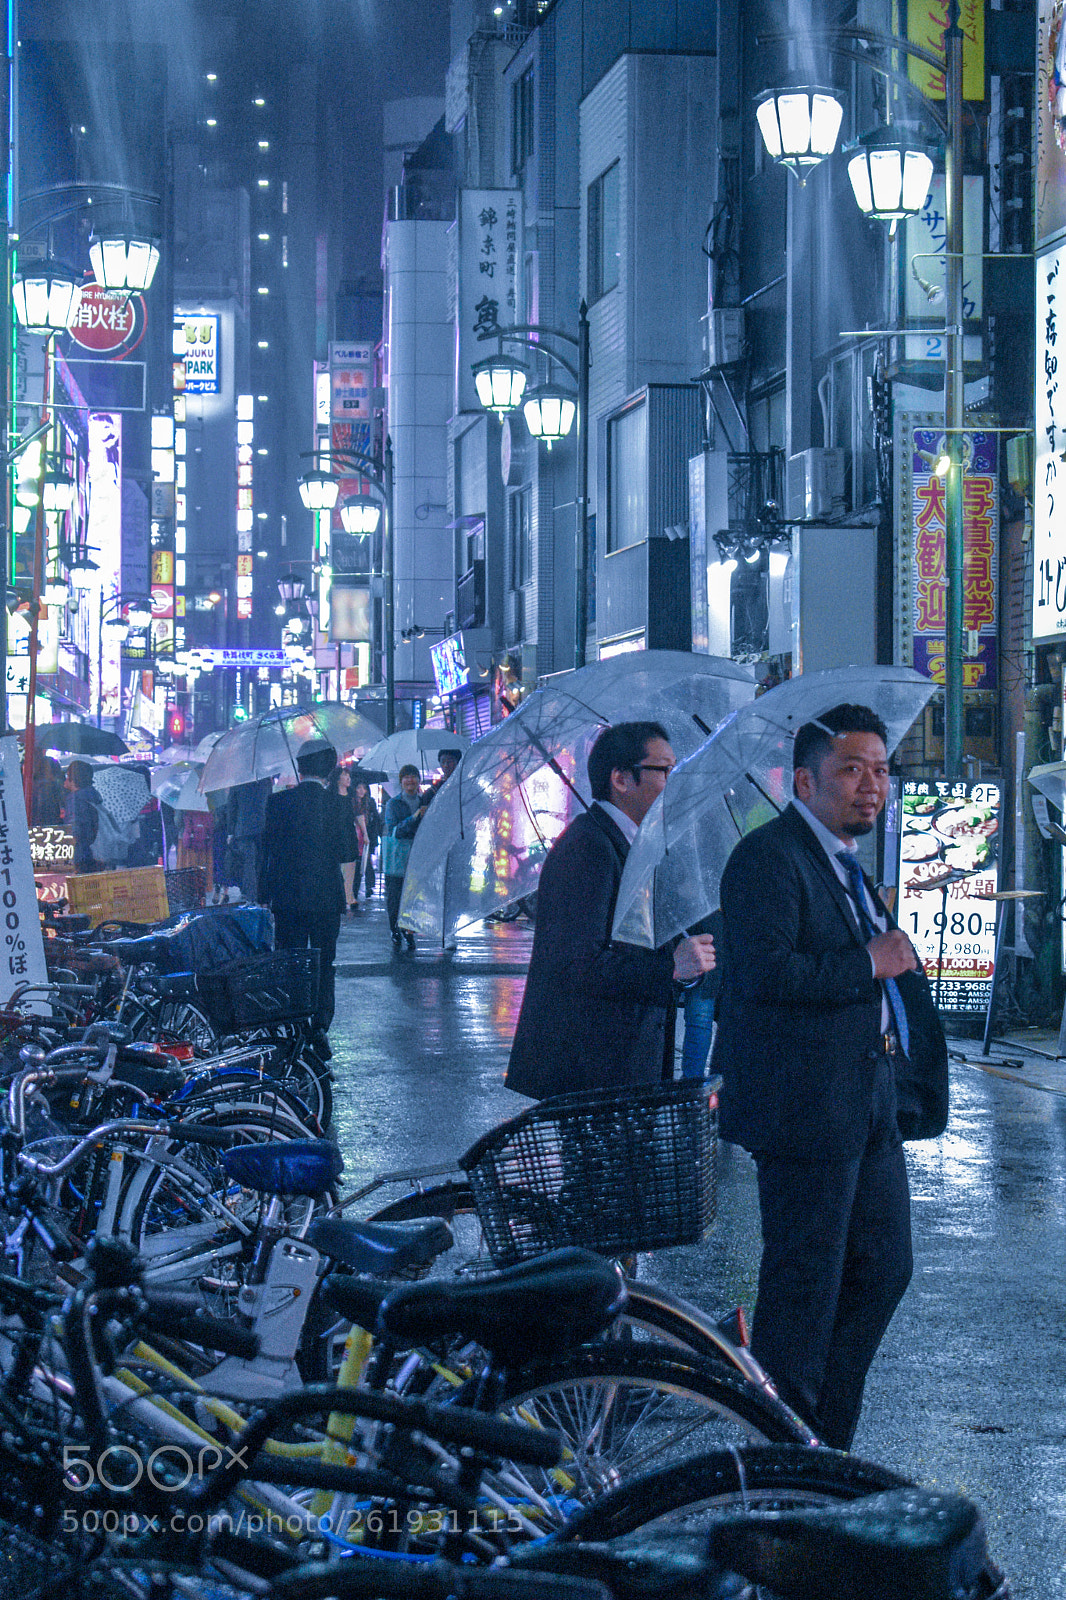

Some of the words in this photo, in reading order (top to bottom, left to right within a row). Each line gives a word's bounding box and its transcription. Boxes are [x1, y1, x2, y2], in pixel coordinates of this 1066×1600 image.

[75, 302, 129, 331] 消火栓
[926, 337, 942, 357] 2
[915, 475, 947, 632] 大歓迎
[904, 782, 929, 795] 焼肉
[975, 787, 997, 803] 2F
[35, 882, 69, 900] バル
[903, 876, 995, 900] 食放題
